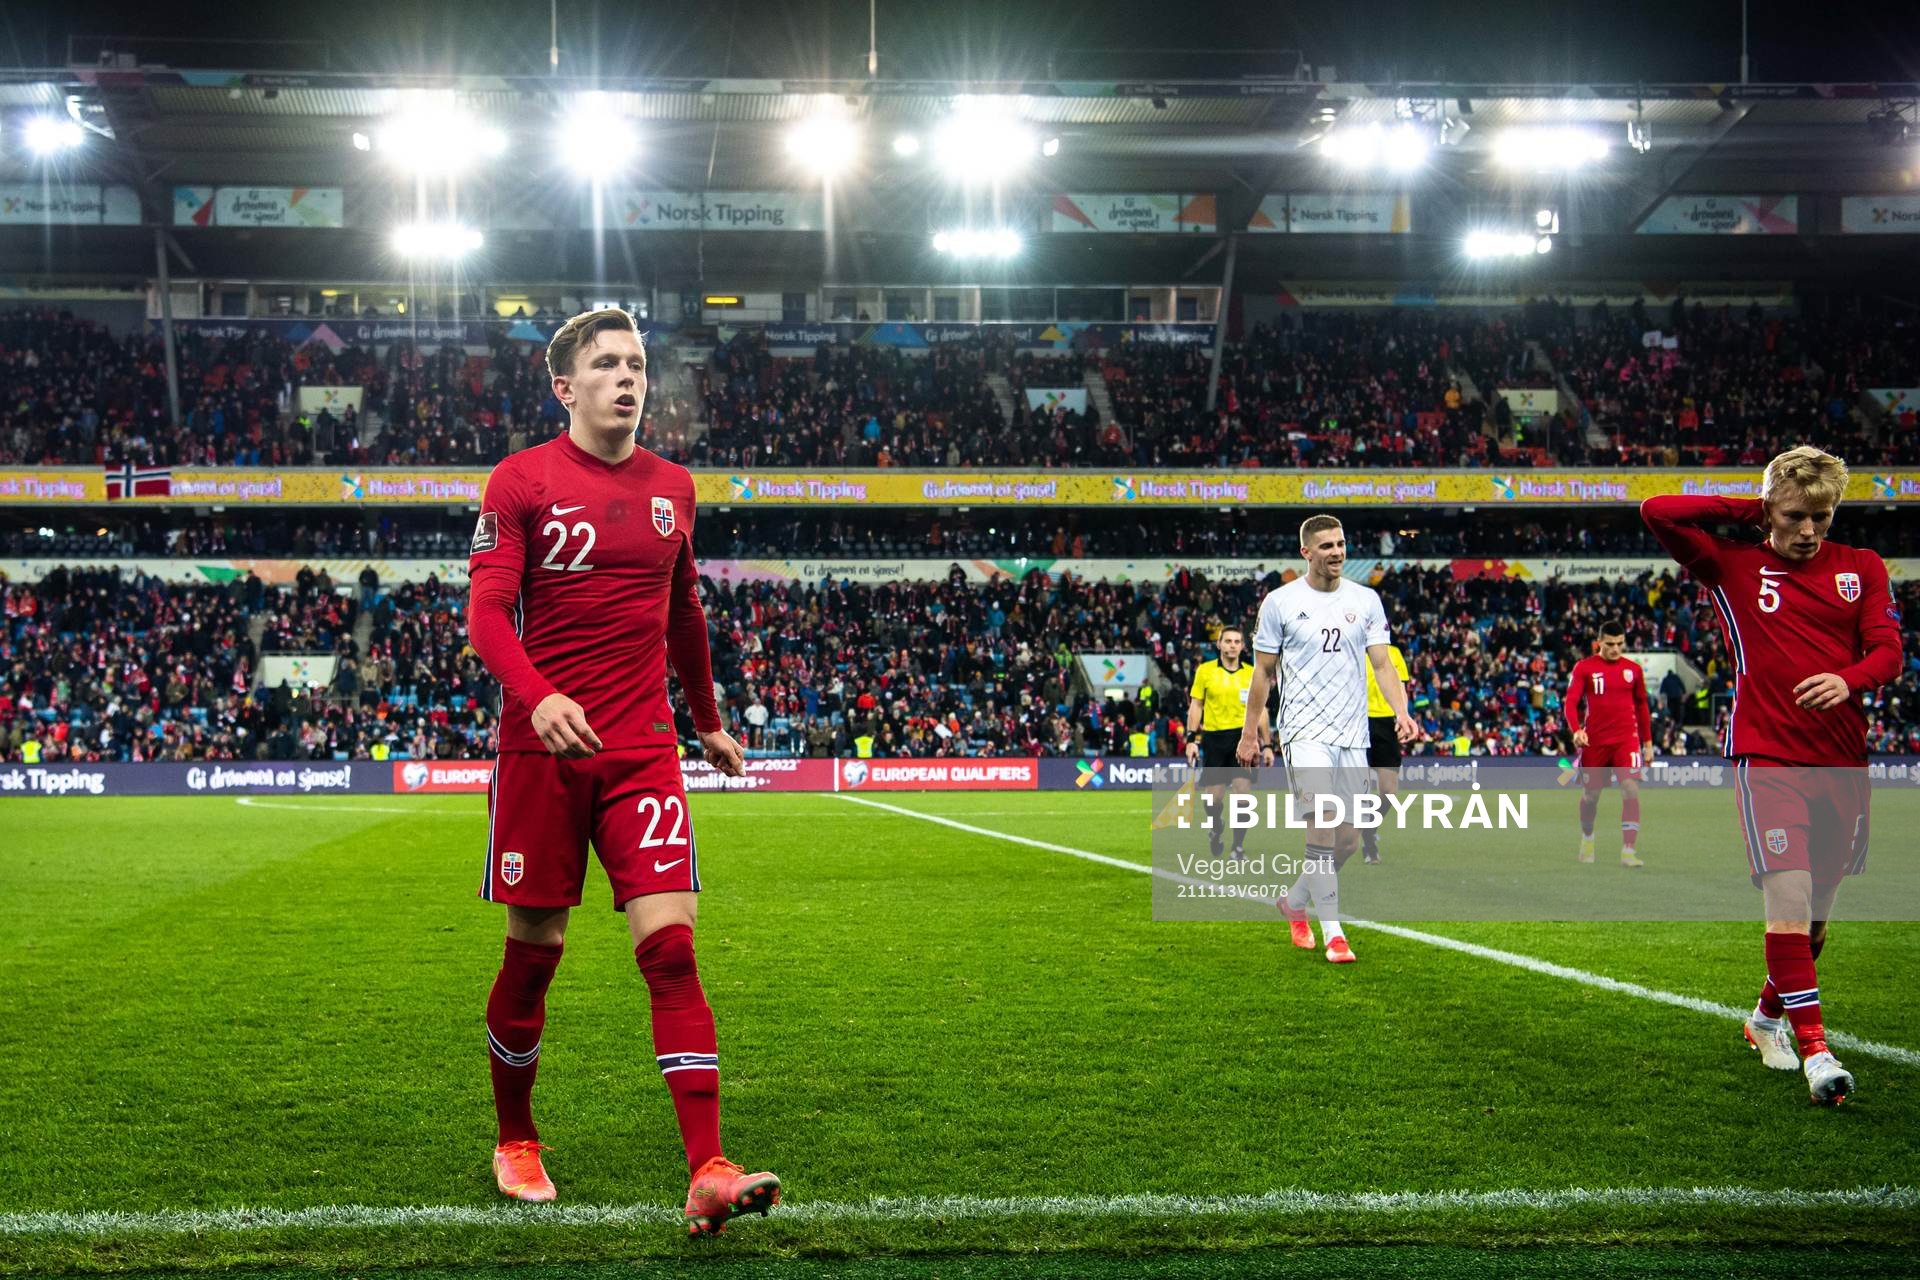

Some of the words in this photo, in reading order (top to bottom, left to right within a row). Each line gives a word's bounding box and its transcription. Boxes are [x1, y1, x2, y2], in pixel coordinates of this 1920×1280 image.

[657, 203, 712, 221] Norsk
[714, 203, 785, 226] Tipping
[1301, 208, 1334, 221] Norsk
[1336, 208, 1380, 223] Tipping
[765, 330, 797, 342] Norsk
[798, 330, 837, 345] Tipping
[21, 478, 85, 499] Tipping
[368, 480, 416, 496] Norsk
[417, 478, 480, 499] Tipping
[757, 481, 804, 497] Norsk
[805, 479, 867, 500] Tipping
[1140, 482, 1187, 498] Norsk
[1188, 480, 1249, 501] Tipping
[1519, 480, 1566, 496] Norsk
[1567, 478, 1627, 500] Tipping
[540, 520, 597, 572] 22
[803, 563, 815, 577] Gi
[858, 566, 870, 576] en
[873, 563, 905, 578] sjanse!
[1758, 578, 1781, 613] 5
[1320, 627, 1341, 653] 22
[1591, 676, 1605, 694] 11
[27, 768, 105, 794] Tipping
[186, 766, 207, 789] Gi
[209, 765, 274, 789] drømmen
[275, 770, 296, 787] en
[298, 765, 352, 792] sjanse!
[871, 766, 947, 782] EUROPEAN
[950, 766, 1031, 783] QUALIFIERS
[1109, 763, 1167, 784] Norsk
[1426, 760, 1478, 787] sjanse!
[1650, 761, 1724, 787] Tipping
[637, 795, 689, 849] 22
